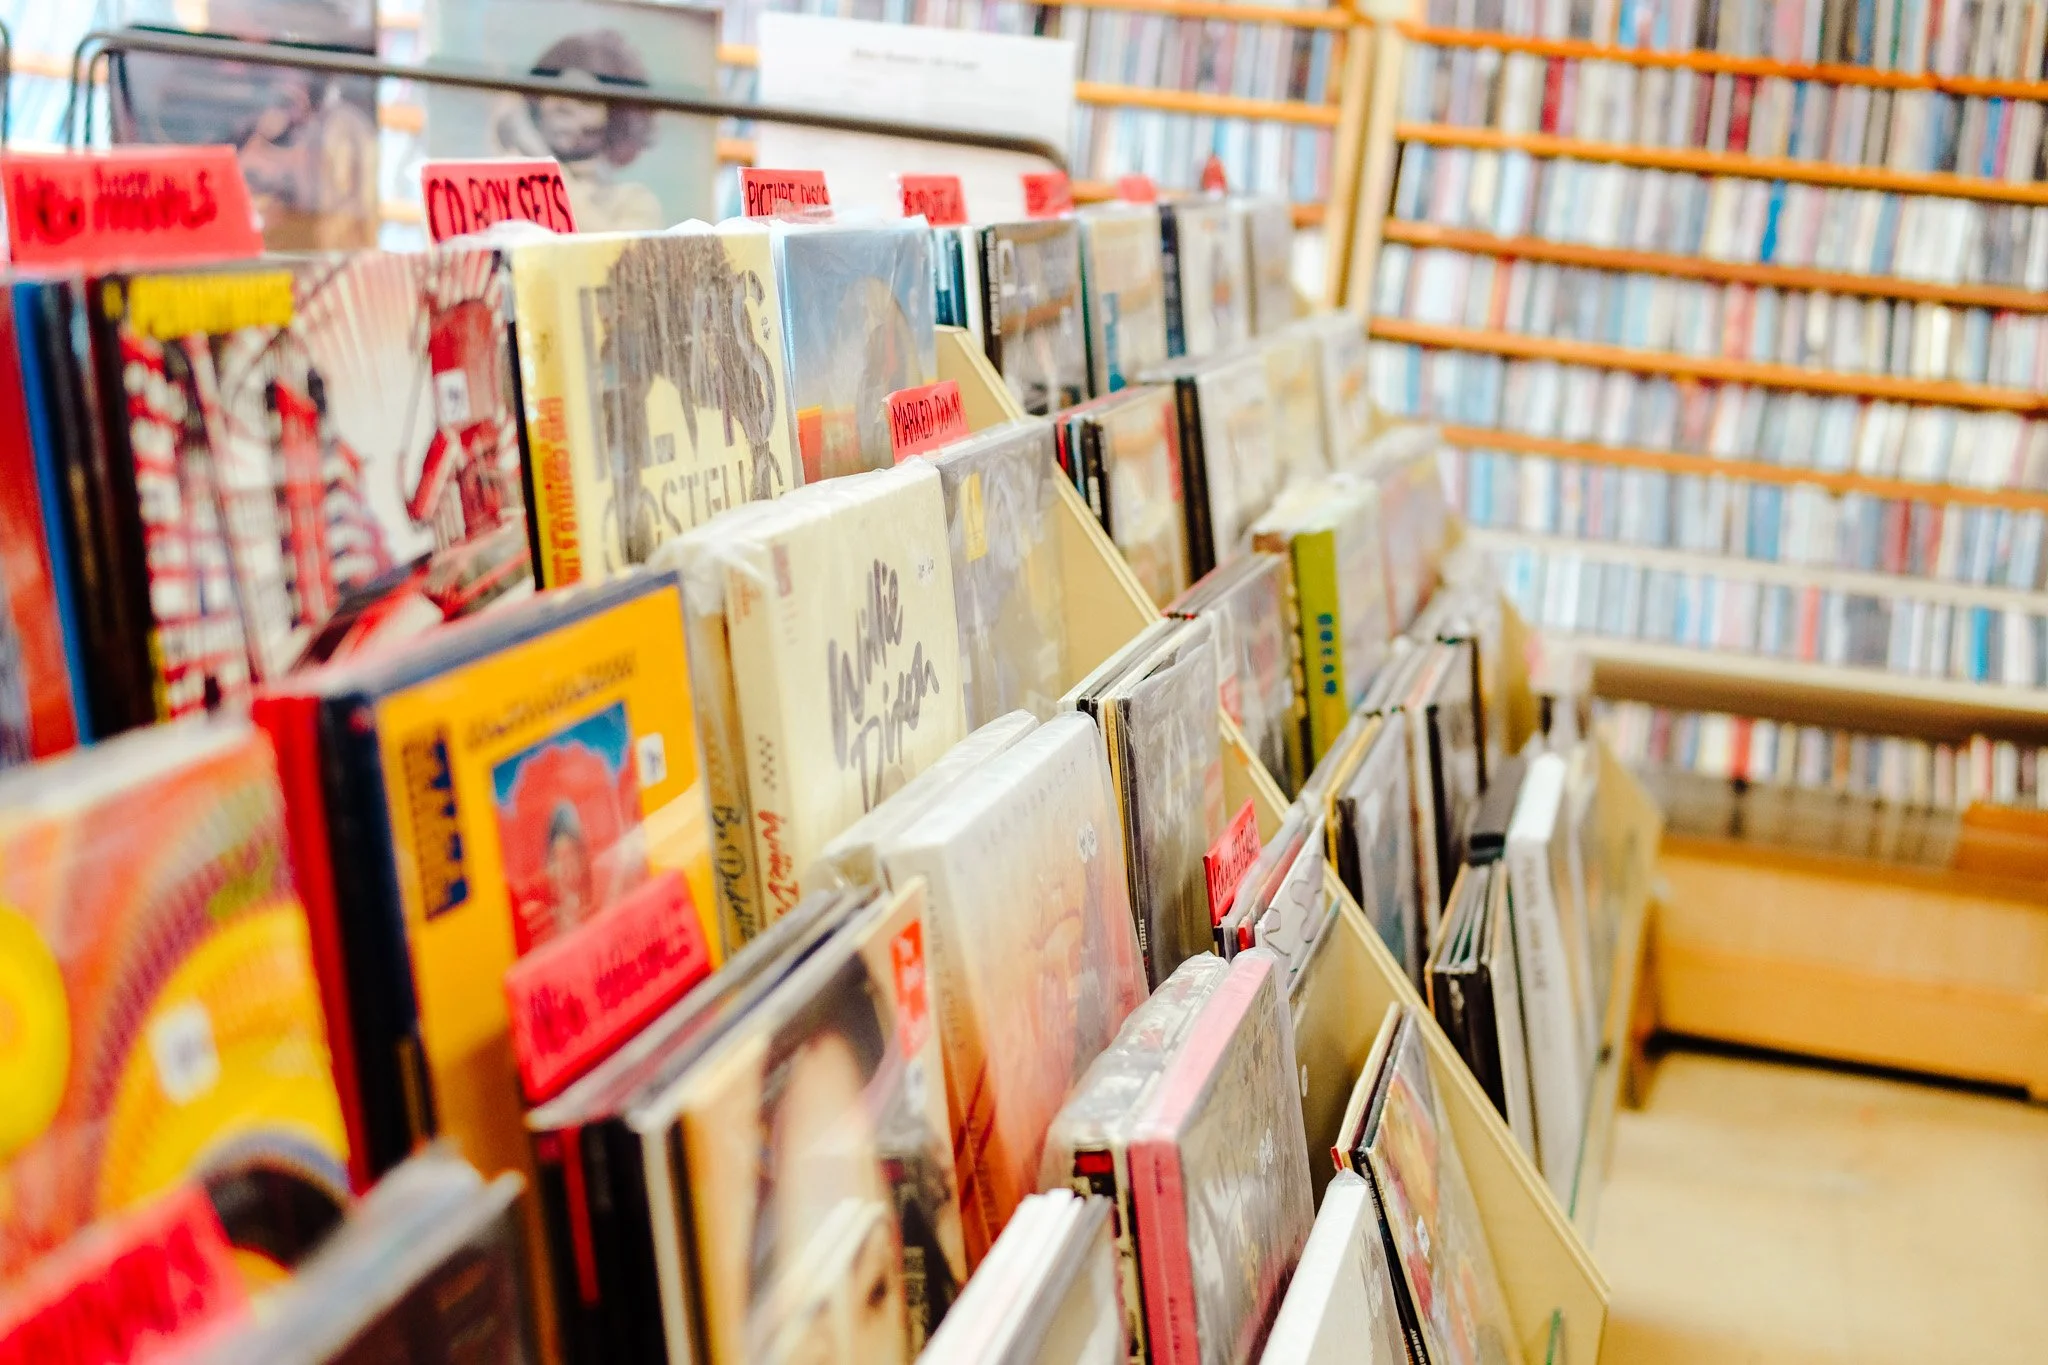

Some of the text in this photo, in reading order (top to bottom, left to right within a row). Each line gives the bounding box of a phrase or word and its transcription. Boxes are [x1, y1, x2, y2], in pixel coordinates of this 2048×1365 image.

[428, 175, 573, 243] CD BOX SETS
[747, 180, 796, 216] PICTURE
[892, 391, 963, 448] MARKED DOWN
[828, 558, 904, 770] Willie
[851, 640, 940, 815] Dixon
